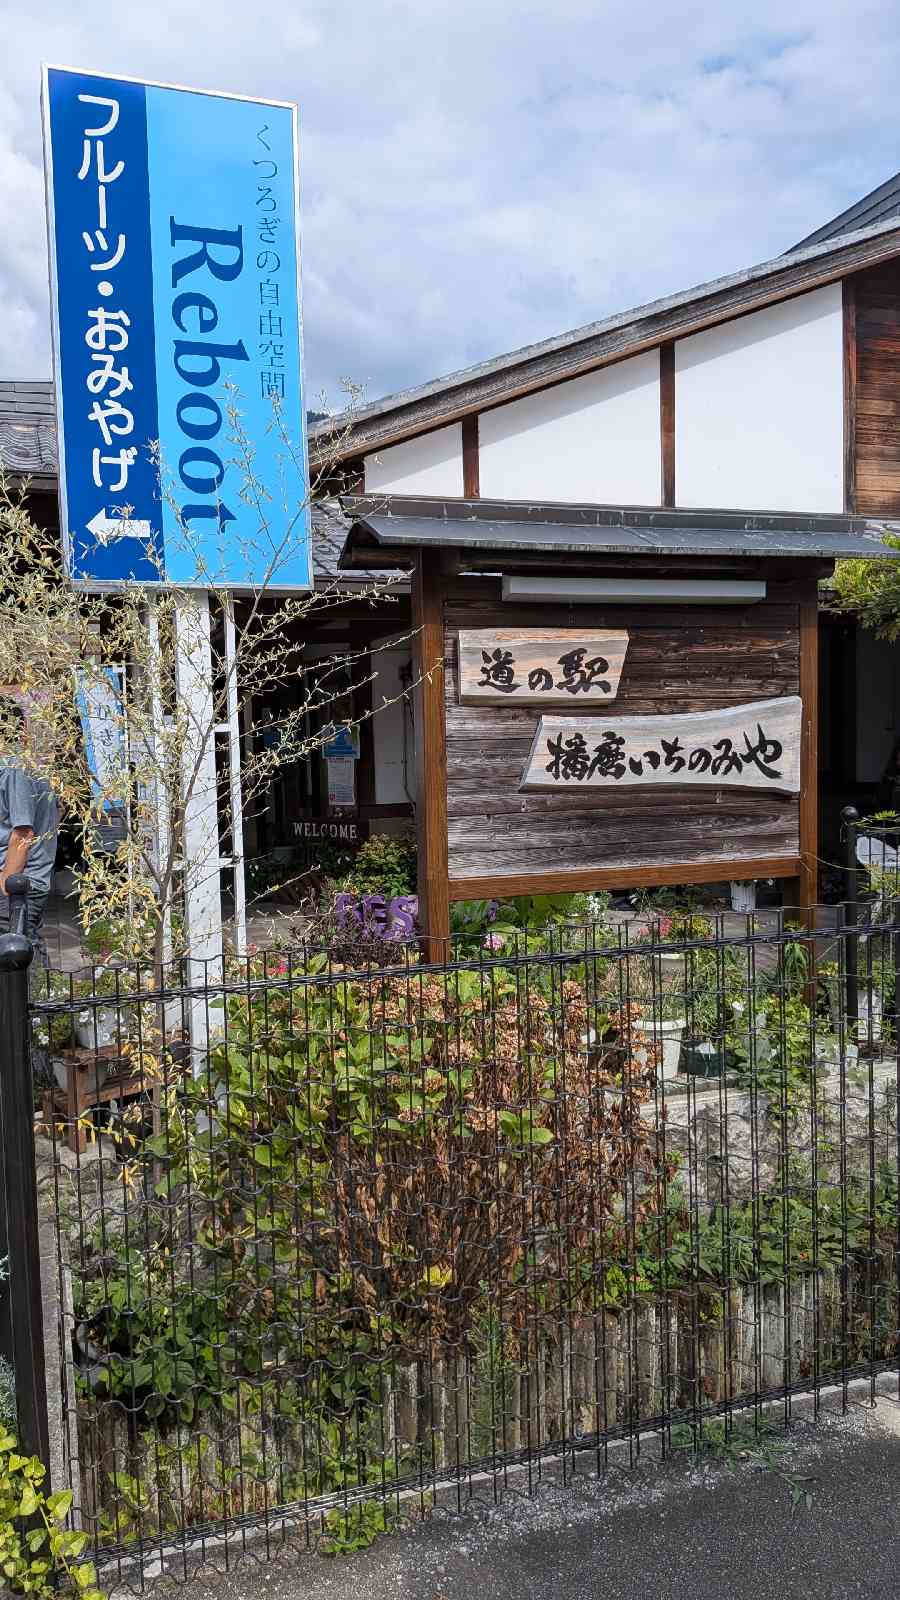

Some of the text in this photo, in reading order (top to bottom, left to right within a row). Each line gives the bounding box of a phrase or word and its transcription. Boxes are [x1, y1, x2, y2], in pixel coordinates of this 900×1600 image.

[77, 93, 138, 493] フルーツ・おみやげ
[250, 123, 286, 399] くつろぎの自由空間
[168, 215, 250, 534] Reboot
[477, 647, 612, 695] 道の駅
[545, 722, 783, 781] 播磨いちのみや
[292, 822, 358, 839] WELCOME
